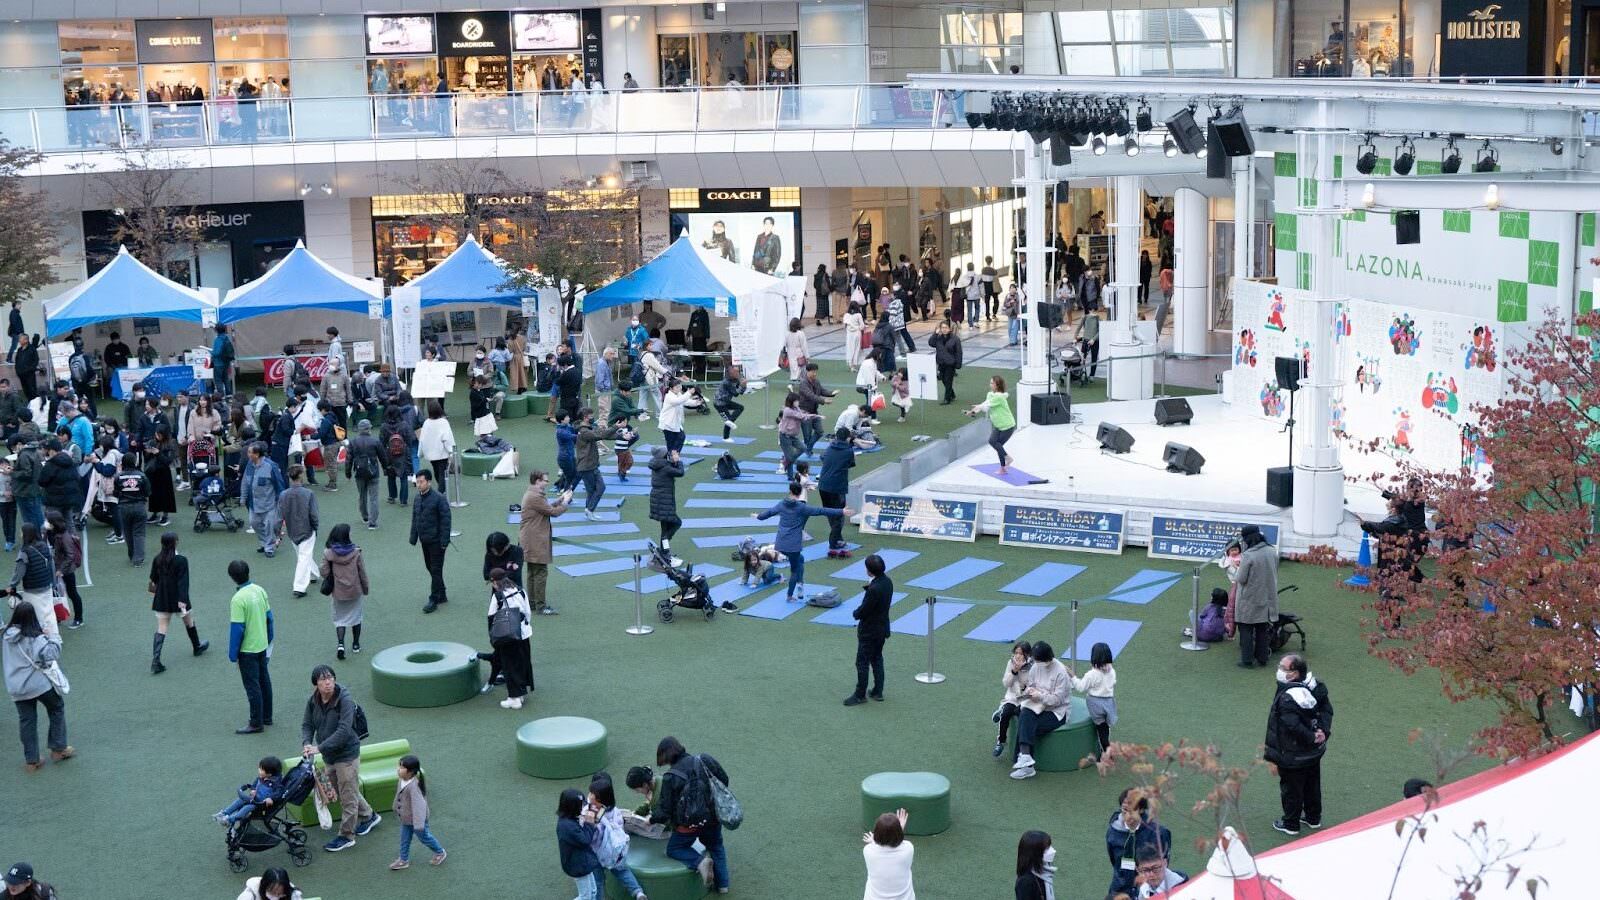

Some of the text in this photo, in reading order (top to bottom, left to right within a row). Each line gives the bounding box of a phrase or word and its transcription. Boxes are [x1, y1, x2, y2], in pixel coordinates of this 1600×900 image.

[1447, 21, 1521, 39] HOLLISTER
[706, 191, 762, 200] COACH
[1345, 252, 1423, 281] LAZONA
[1016, 509, 1054, 521] BLACK
[1057, 511, 1096, 525] FRIDAY
[1165, 521, 1205, 533] BLACK
[1209, 524, 1243, 537] FRIDA
